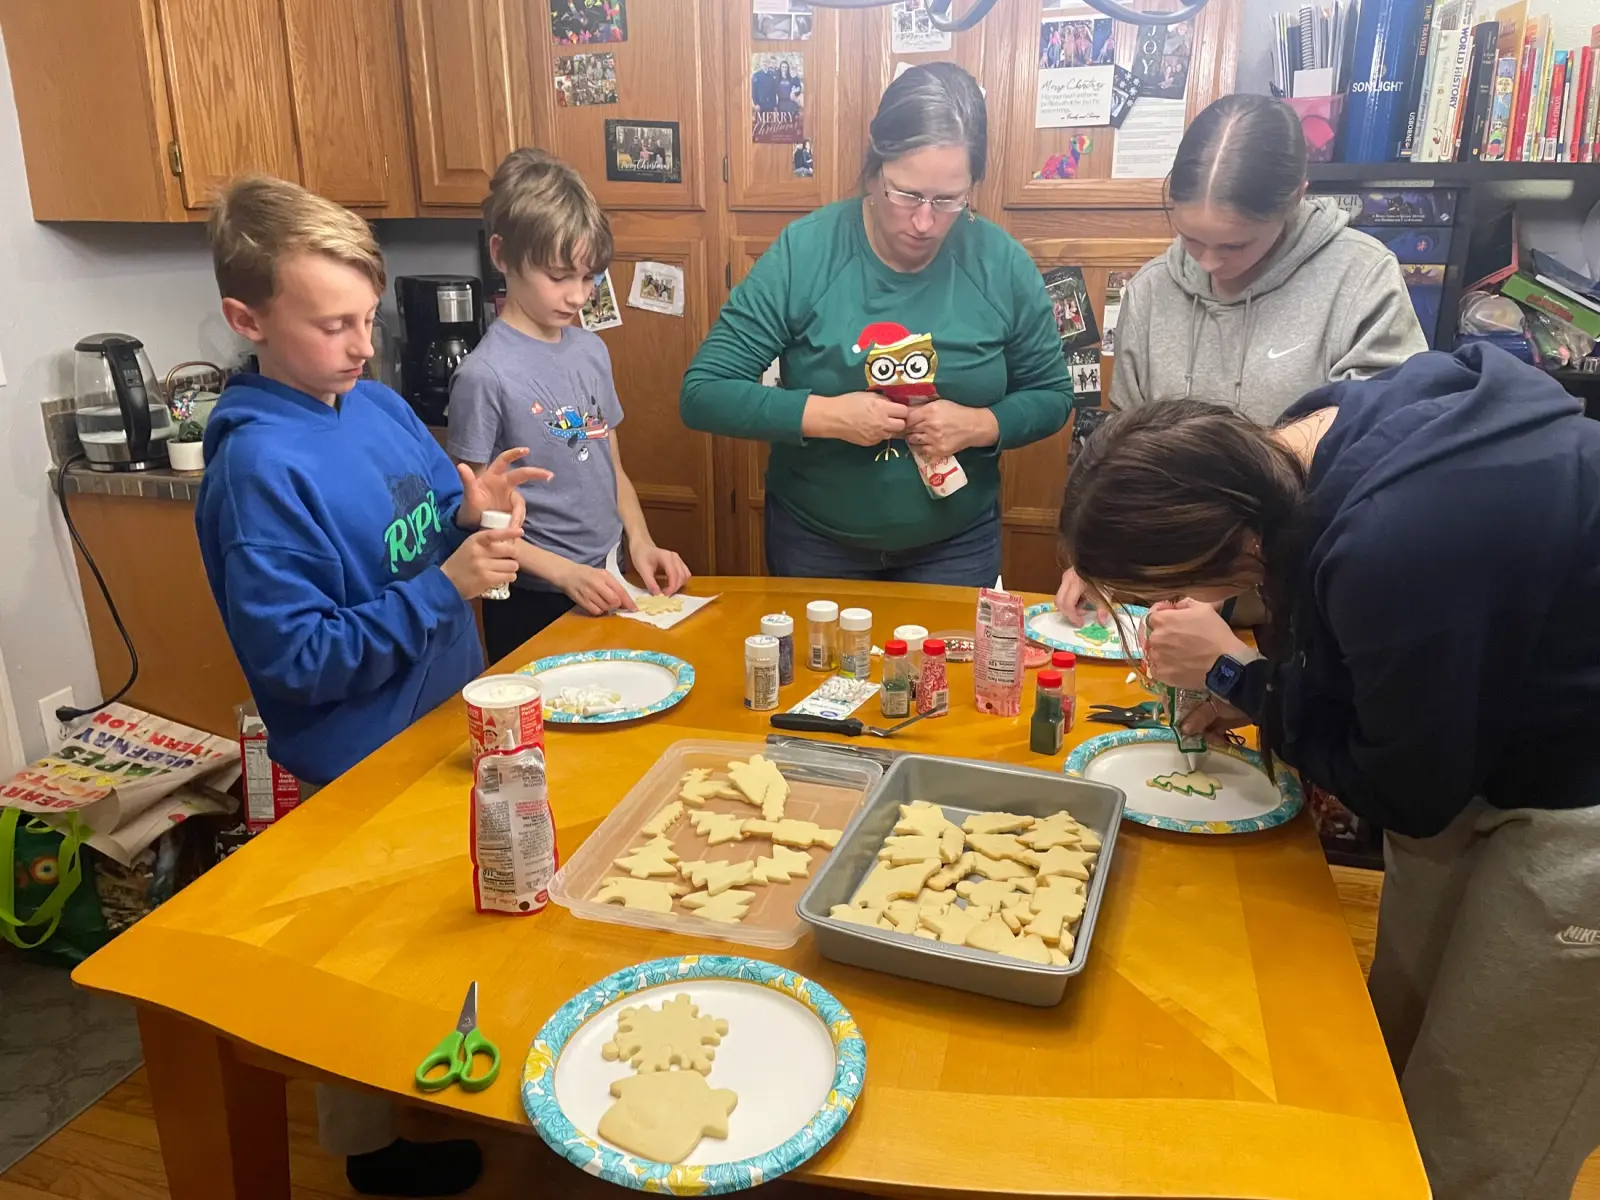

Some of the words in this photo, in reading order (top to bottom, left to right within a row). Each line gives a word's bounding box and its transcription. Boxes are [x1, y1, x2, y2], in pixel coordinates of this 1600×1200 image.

[1424, 4, 1433, 21] TIME
[1418, 23, 1430, 56] TRAVELER
[1456, 27, 1470, 65] WORLD
[1352, 81, 1404, 93] SONLIGHT
[1449, 66, 1463, 110] HISTORY
[756, 111, 793, 123] MERRY
[1552, 95, 1562, 117] WORD
[1405, 111, 1416, 143] USBORNE
[1563, 925, 1600, 942] NIKE
